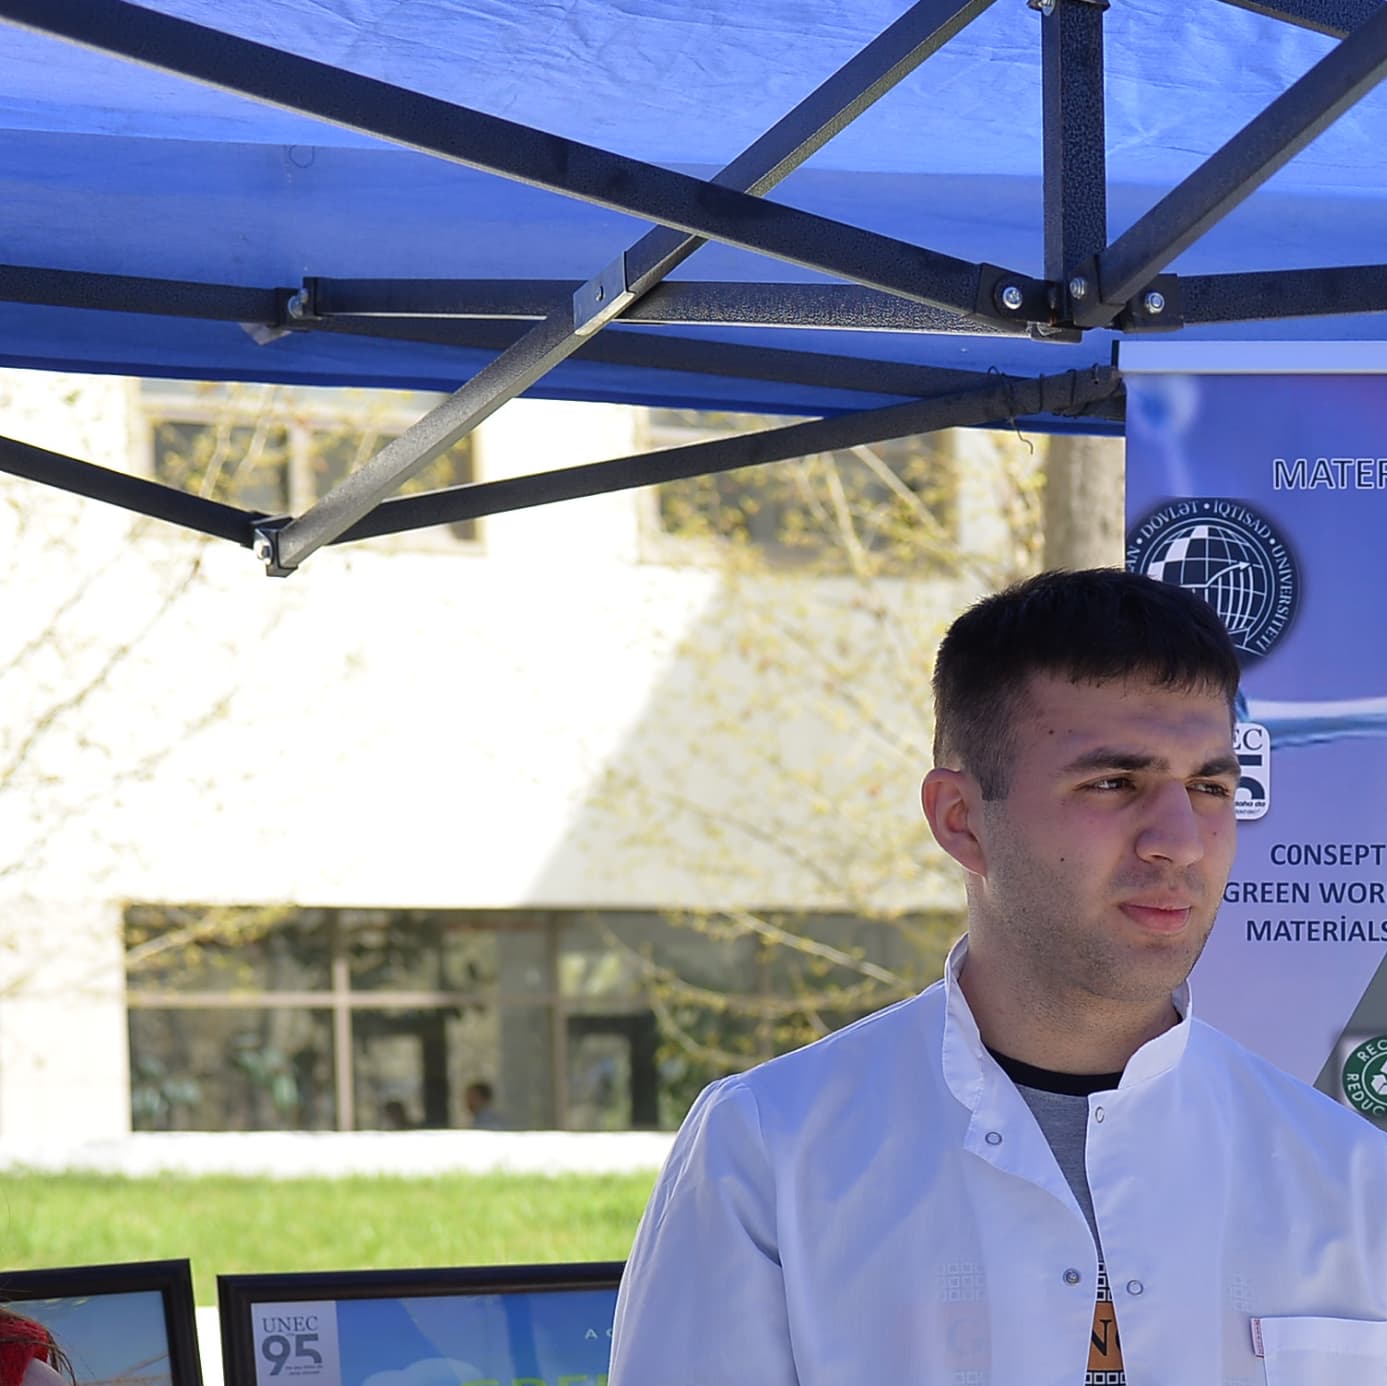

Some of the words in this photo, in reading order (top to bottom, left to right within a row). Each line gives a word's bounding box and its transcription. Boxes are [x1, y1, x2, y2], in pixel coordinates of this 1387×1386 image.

[1222, 881, 1311, 906] GREEN
[262, 1316, 319, 1333] UNEC
[262, 1334, 323, 1376] 95
